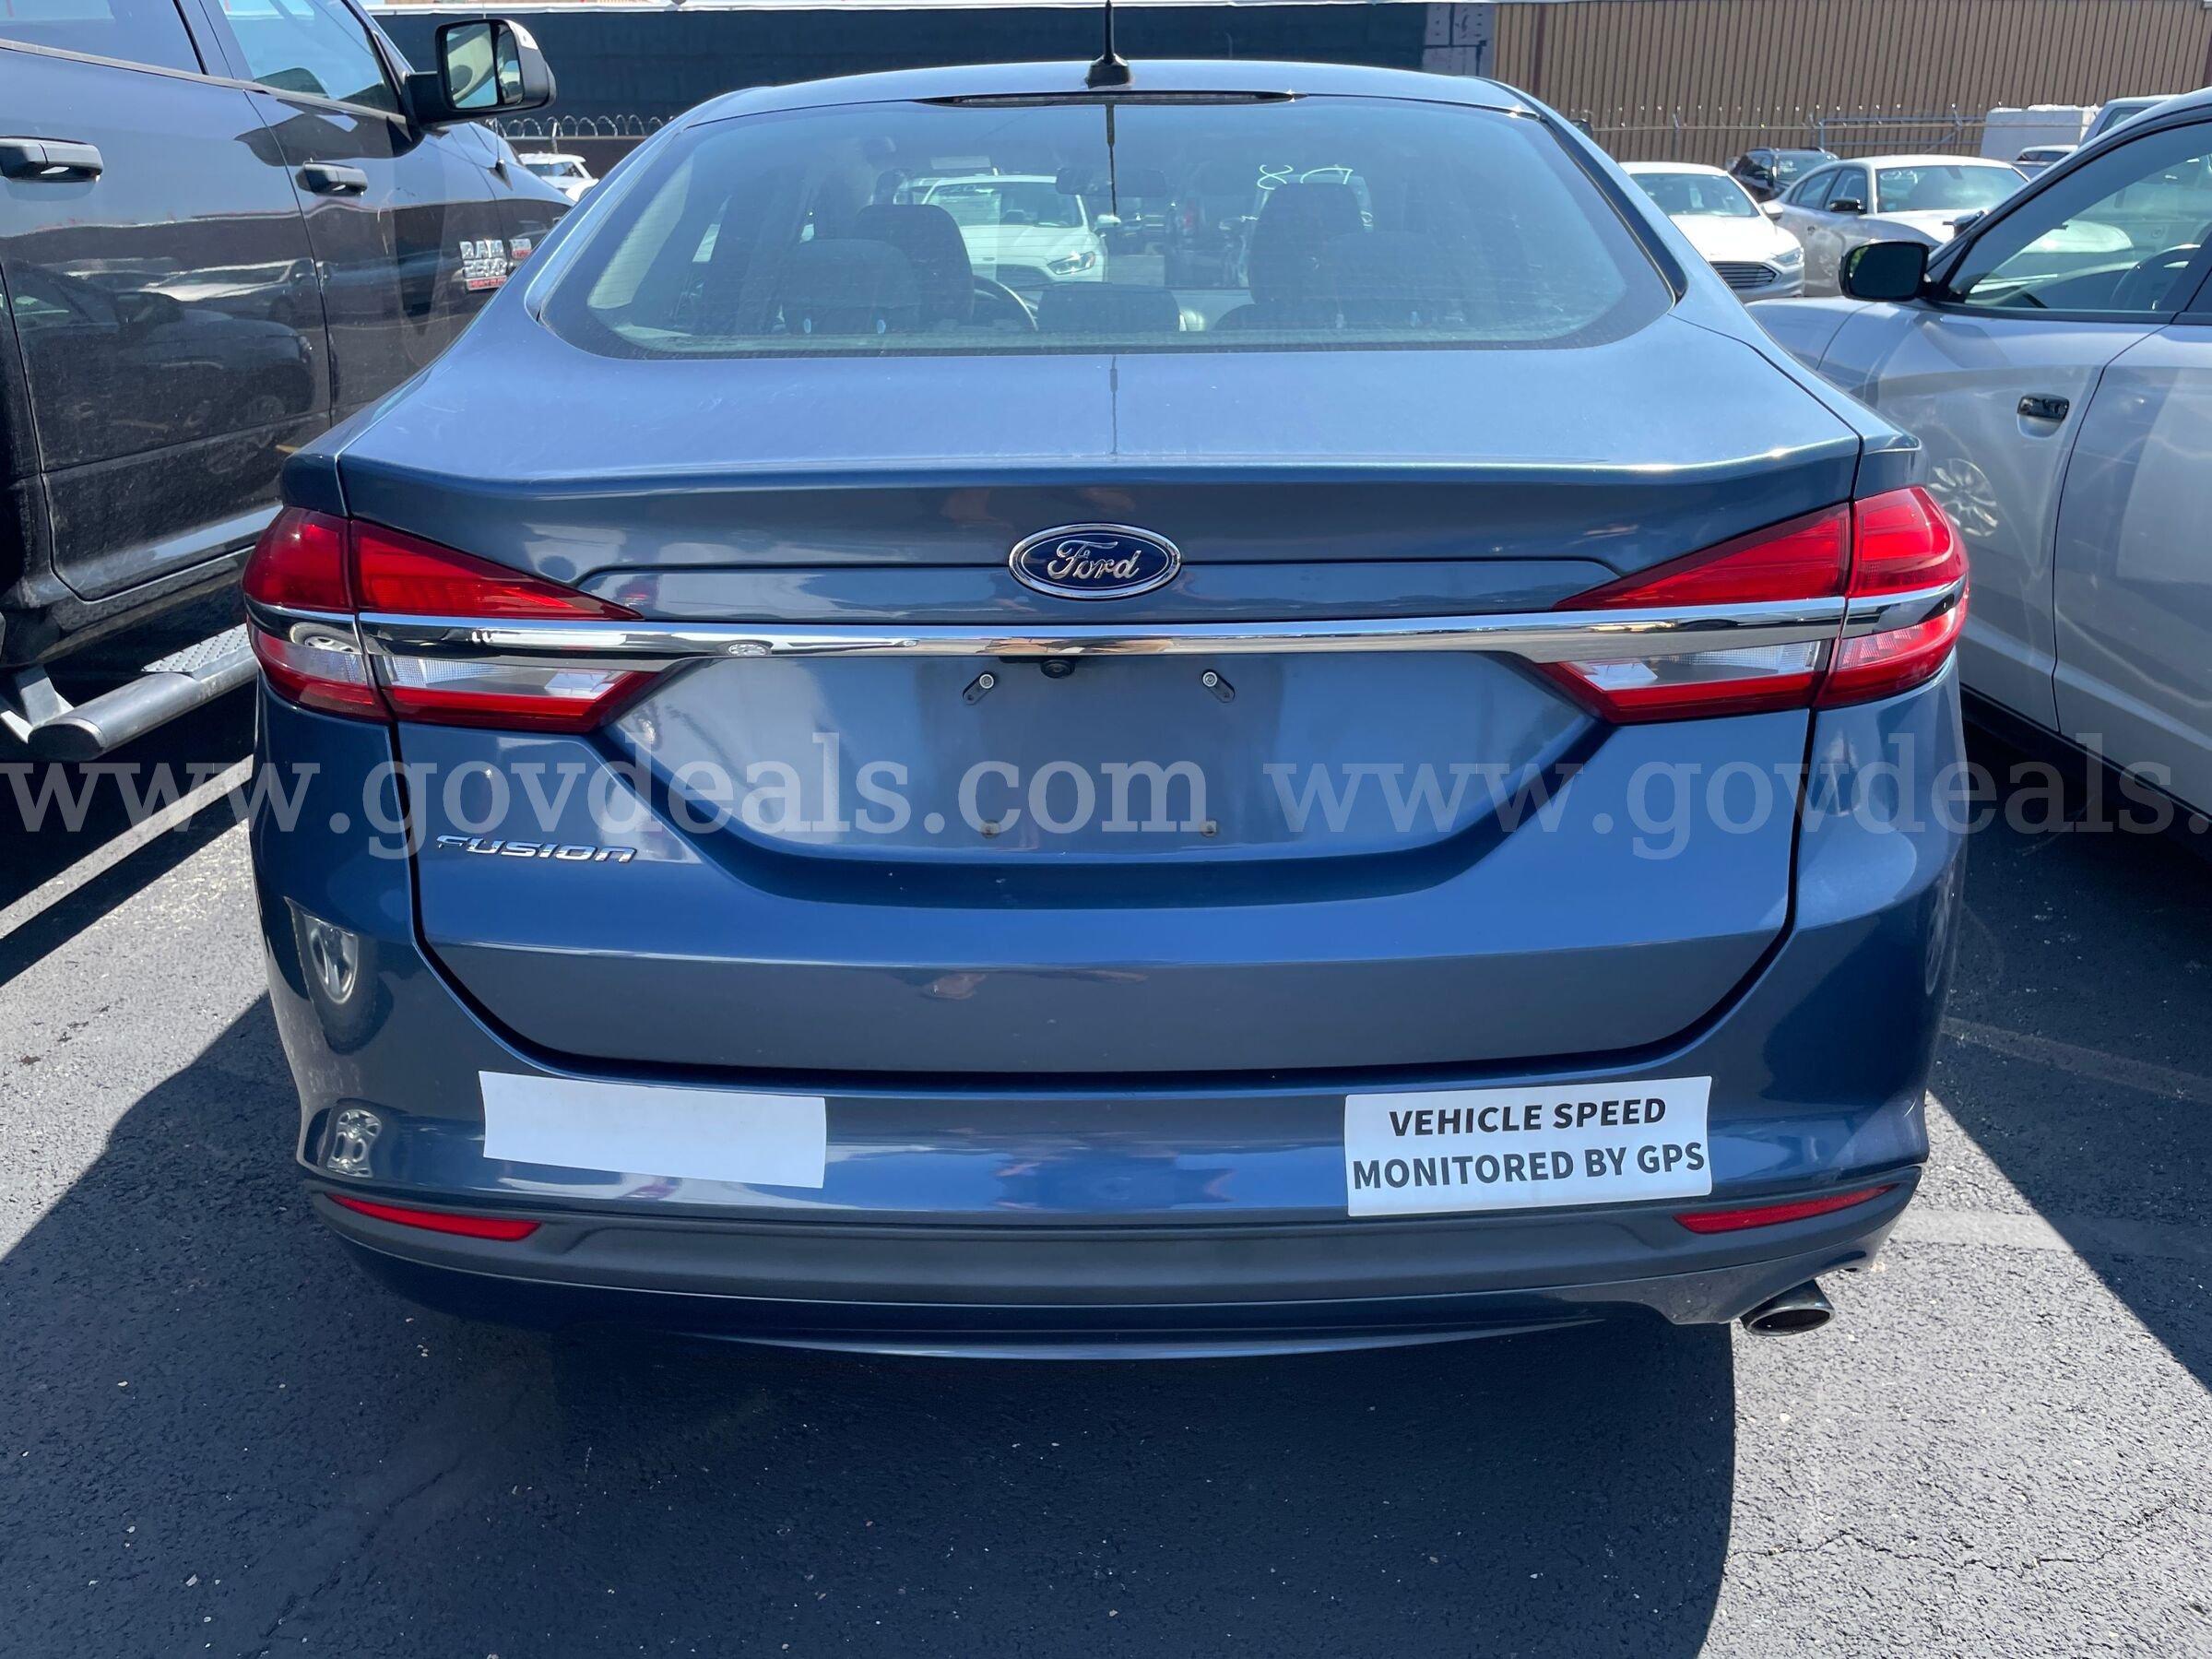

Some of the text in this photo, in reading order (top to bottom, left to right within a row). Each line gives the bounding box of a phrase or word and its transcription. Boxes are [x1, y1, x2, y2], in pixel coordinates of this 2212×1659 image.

[459, 240, 505, 259] RAM
[1047, 539, 1141, 580] Ford
[1390, 1098, 1666, 1136] VEHICLE SPEED
[1353, 1142, 1705, 1190] MONITORED BY GPS
